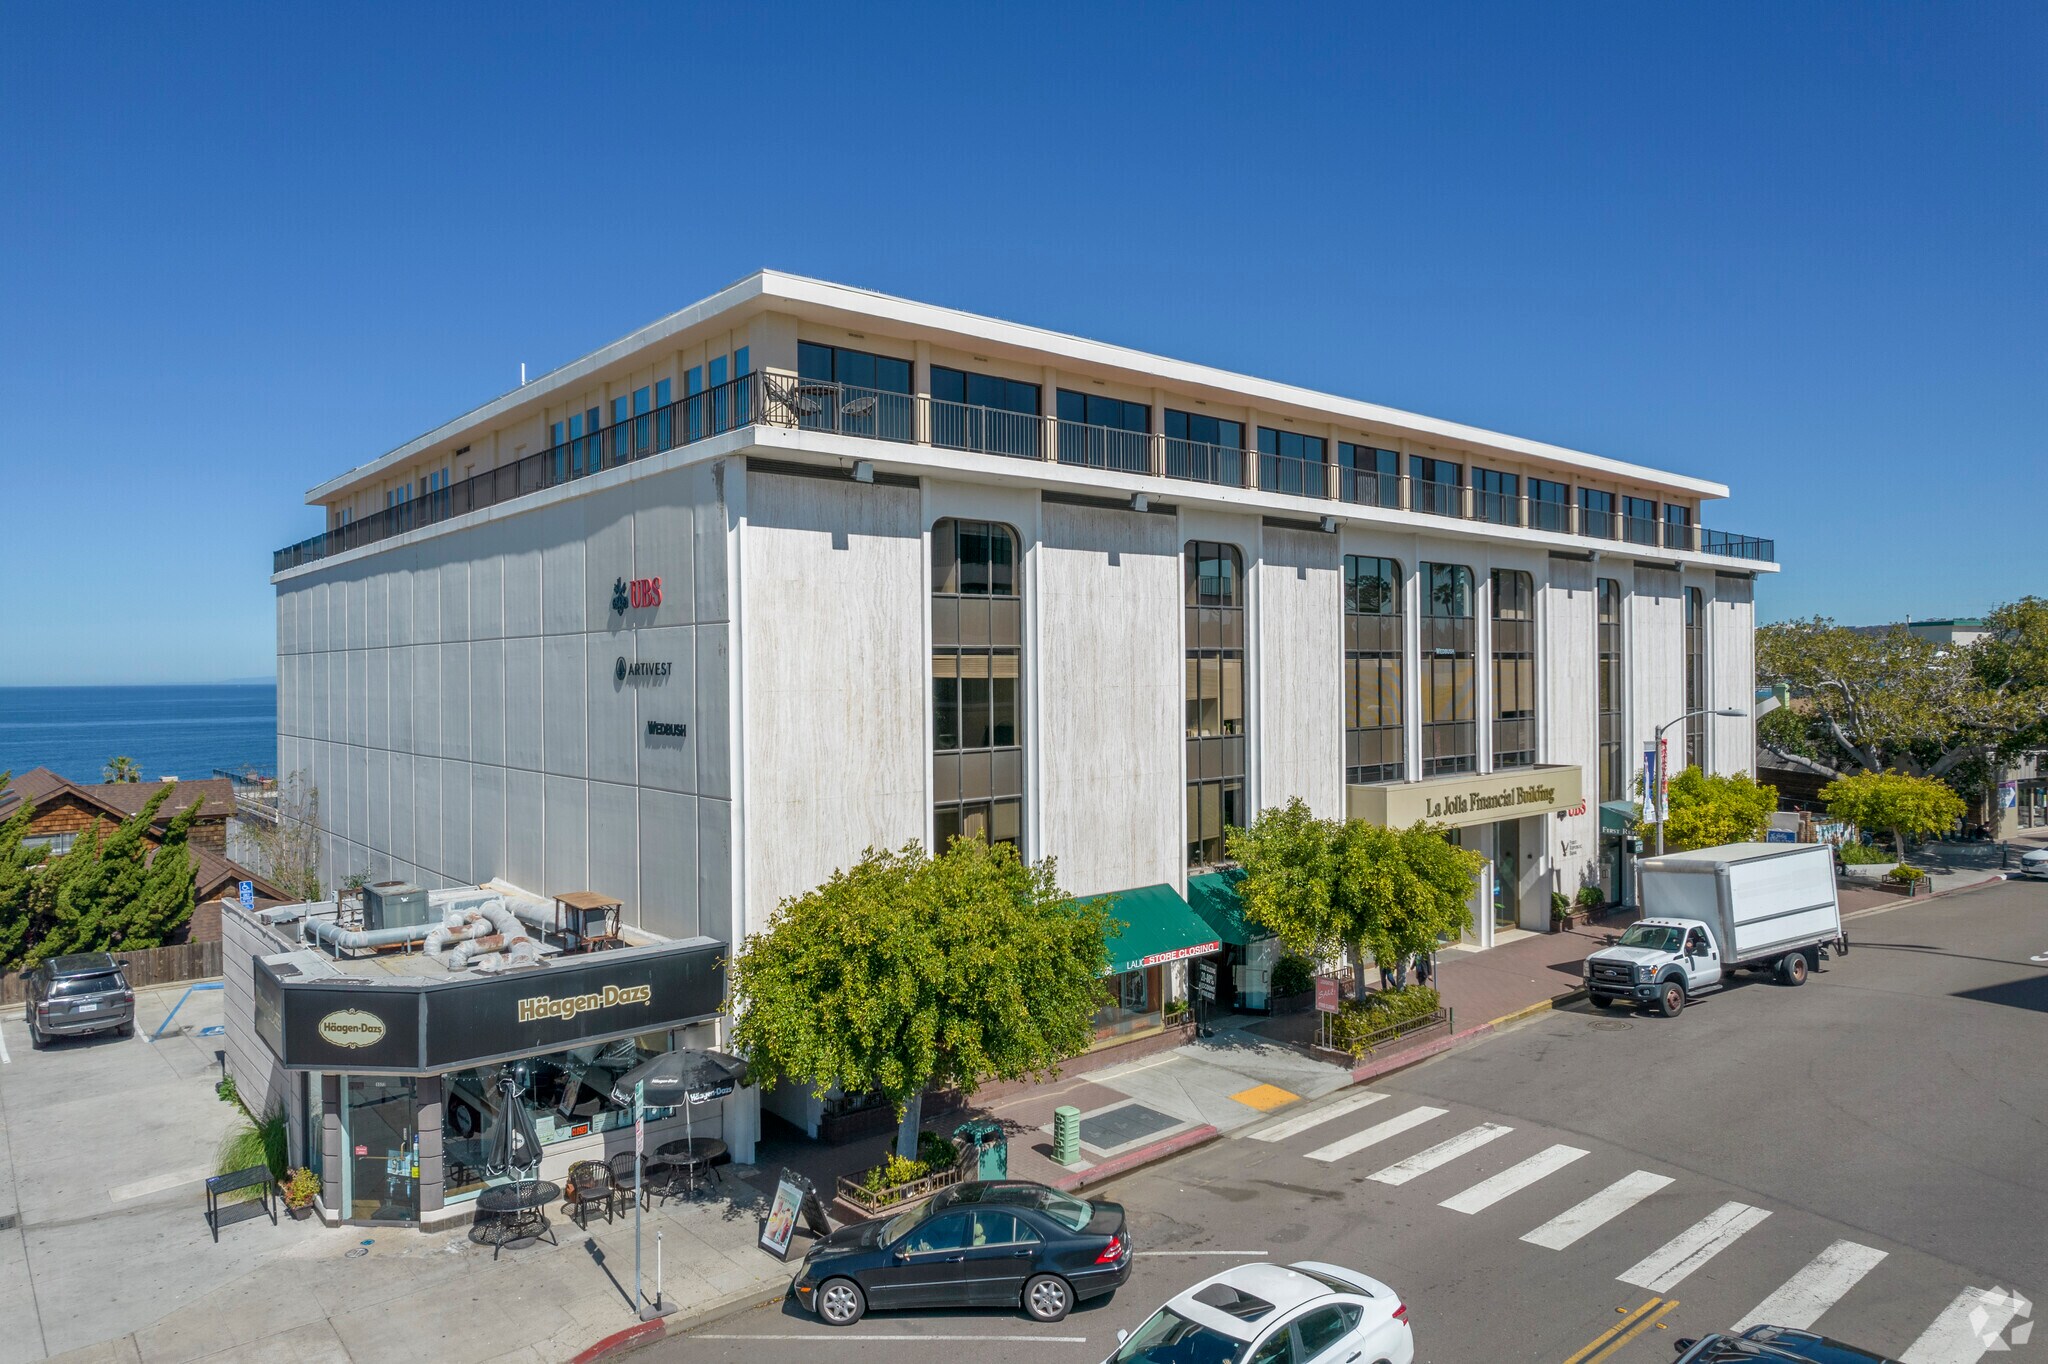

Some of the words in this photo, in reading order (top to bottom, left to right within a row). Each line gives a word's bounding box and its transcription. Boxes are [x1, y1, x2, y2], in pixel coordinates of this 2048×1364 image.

[629, 576, 663, 609] UBS
[628, 661, 673, 676] ARTIVEST
[647, 720, 687, 737] WEDBUSH
[1426, 798, 1442, 818] La
[1444, 794, 1468, 816] Jolla
[1469, 787, 1515, 812] Financial
[1516, 784, 1556, 804] Building
[1149, 950, 1177, 964] STORE
[1178, 943, 1214, 957] CLOSING
[518, 985, 651, 1022] Häagen-Dazs
[323, 1022, 383, 1035] Häagen-Dazs
